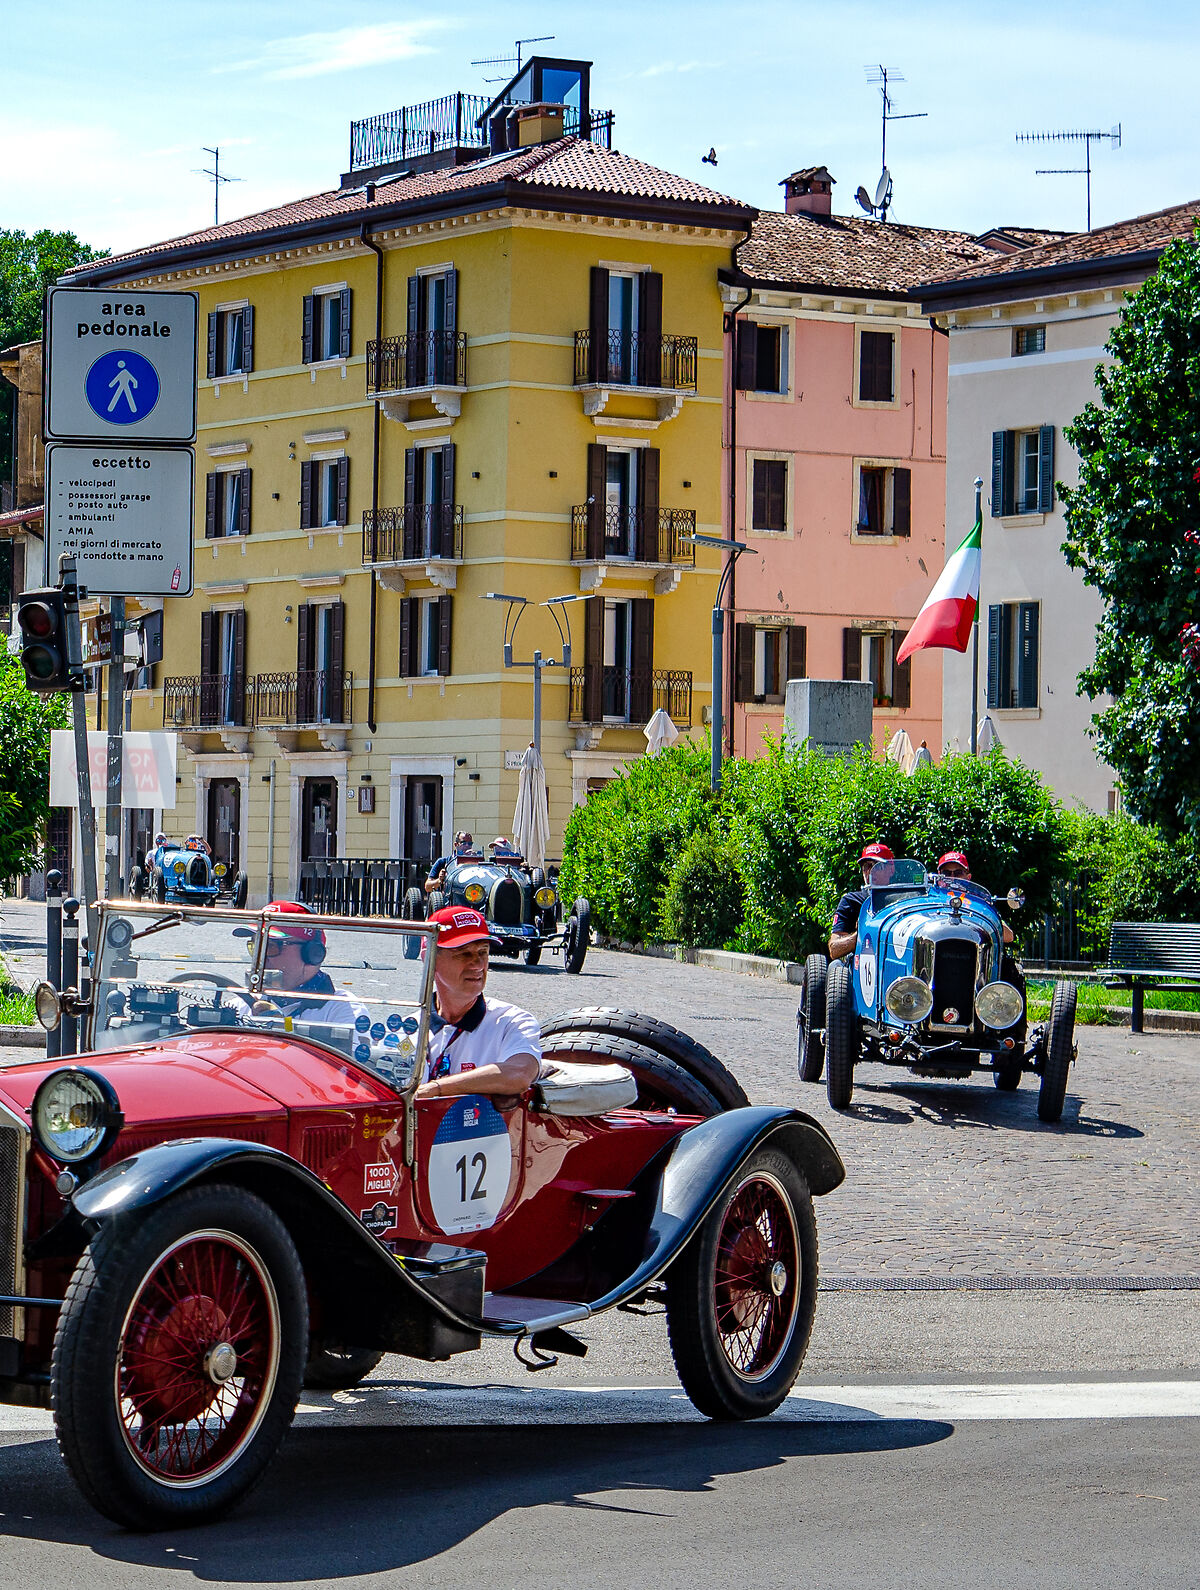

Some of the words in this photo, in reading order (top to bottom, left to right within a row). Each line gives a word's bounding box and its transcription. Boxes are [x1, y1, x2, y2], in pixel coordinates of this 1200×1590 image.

[101, 303, 146, 316] area
[77, 320, 171, 338] pedonale
[92, 456, 151, 469] eccetto
[69, 479, 116, 488] velocipedi
[68, 492, 116, 501] possessori
[120, 494, 151, 502] garage
[77, 502, 104, 510] posto
[68, 514, 115, 522] ambulanti
[68, 527, 94, 535] AMIA
[63, 539, 78, 547] nei
[80, 540, 108, 549] giorni
[110, 540, 120, 548] di
[122, 540, 162, 549] mercato
[83, 552, 127, 560] condotte
[303, 928, 314, 937] 12
[864, 961, 872, 986] 16
[369, 1167, 390, 1178] 1000
[456, 1151, 487, 1203] 12
[367, 1179, 391, 1190] MIGLIA
[365, 1220, 392, 1228] CHOPARD
